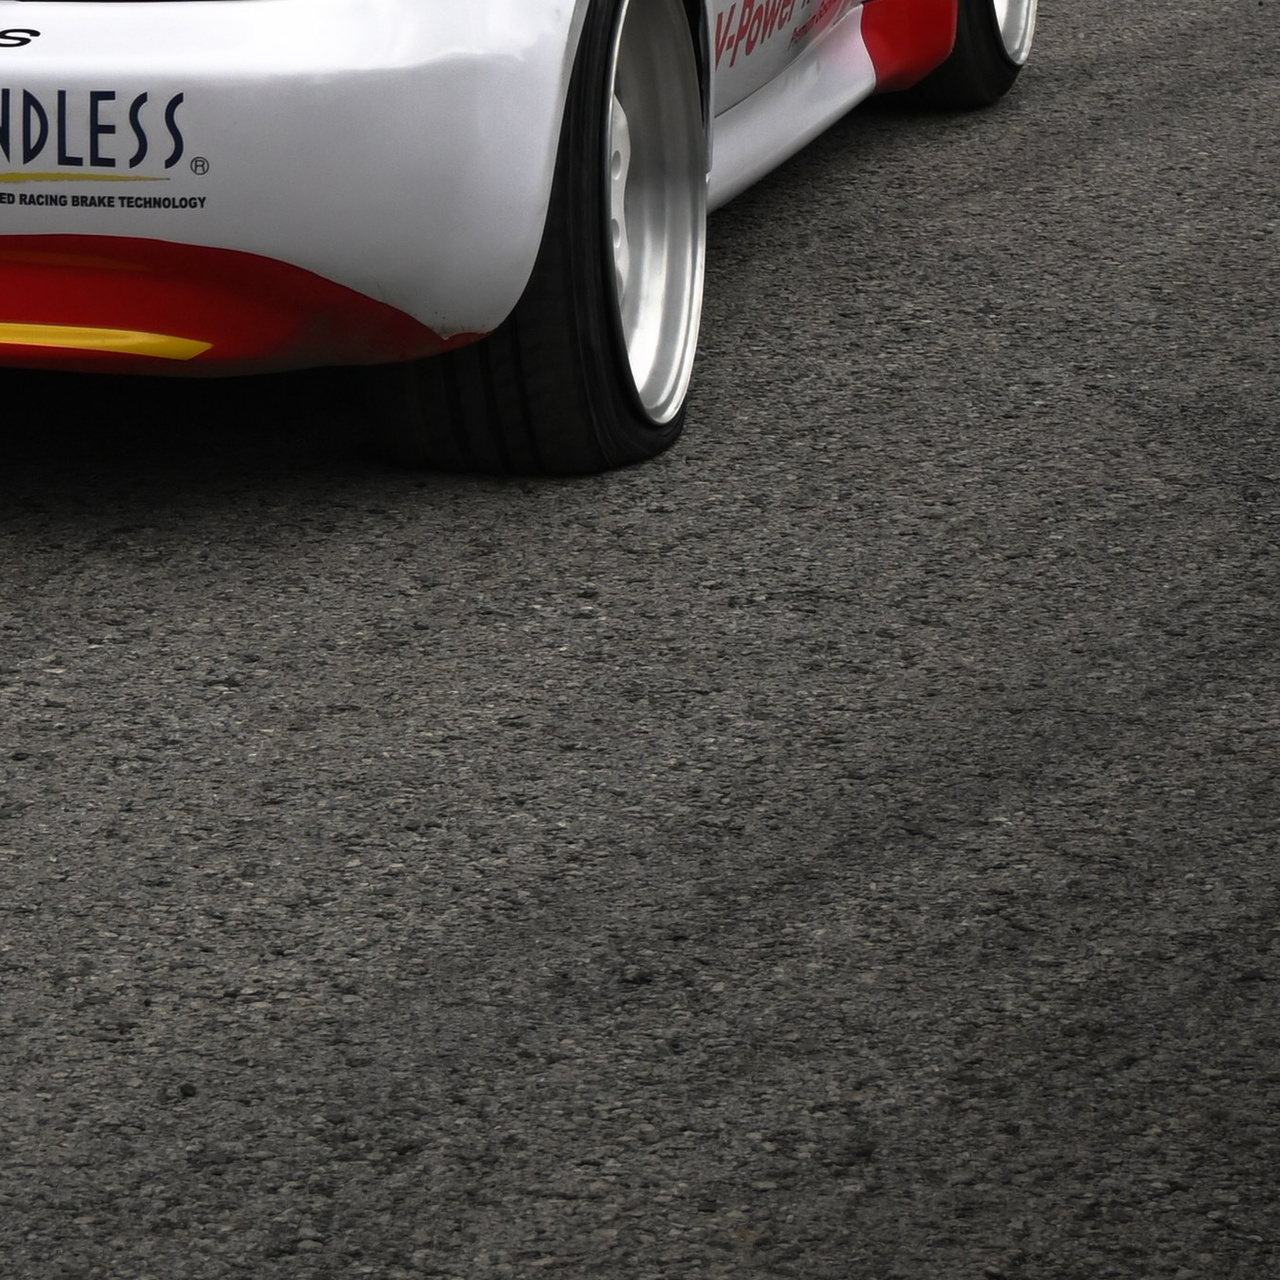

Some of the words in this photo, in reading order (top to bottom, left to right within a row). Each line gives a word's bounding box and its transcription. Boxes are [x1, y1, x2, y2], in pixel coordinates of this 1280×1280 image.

[19, 193, 68, 207] RACING
[71, 195, 116, 208] BRAKE
[117, 196, 207, 209] TECHNOLOGY
